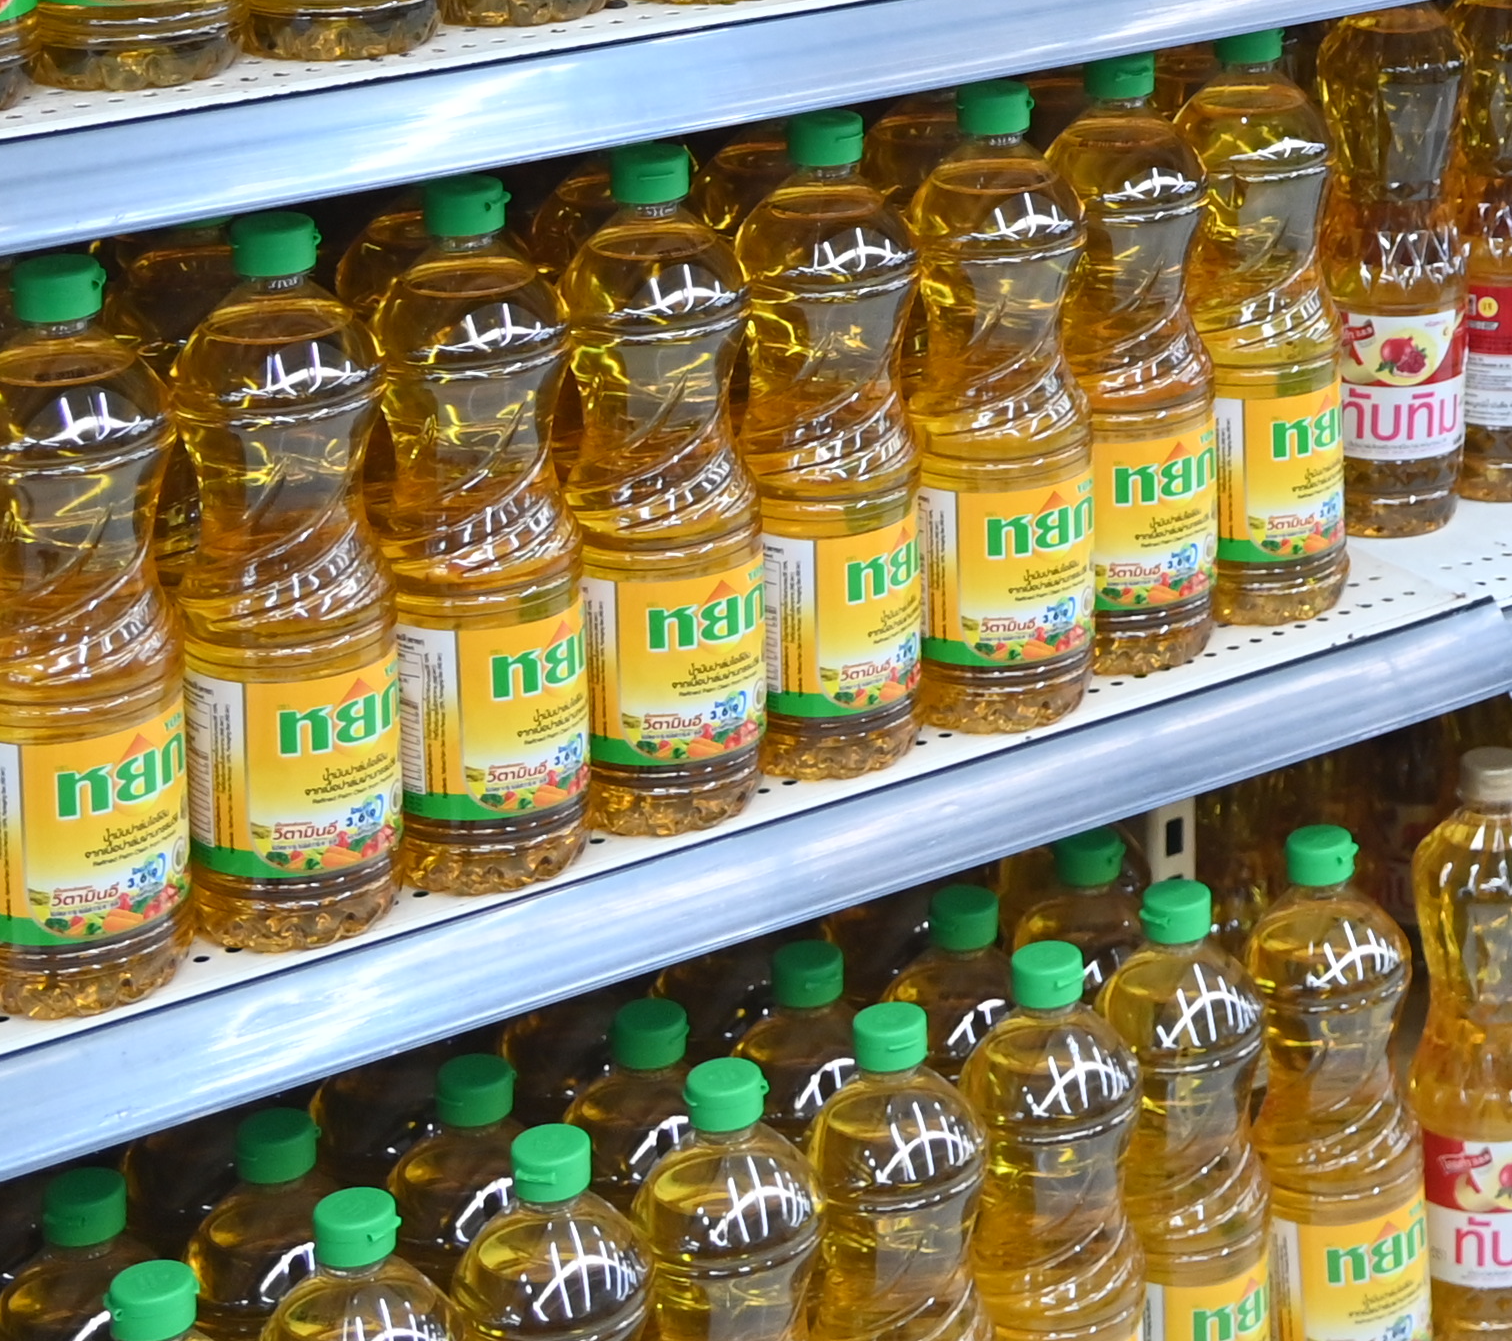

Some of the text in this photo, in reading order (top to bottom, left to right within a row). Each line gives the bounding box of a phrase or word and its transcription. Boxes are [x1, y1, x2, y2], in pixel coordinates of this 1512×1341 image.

[1273, 411, 1341, 459] หย
[1344, 389, 1457, 442] ทับทิม
[847, 543, 921, 602] หย
[492, 633, 588, 700] หย
